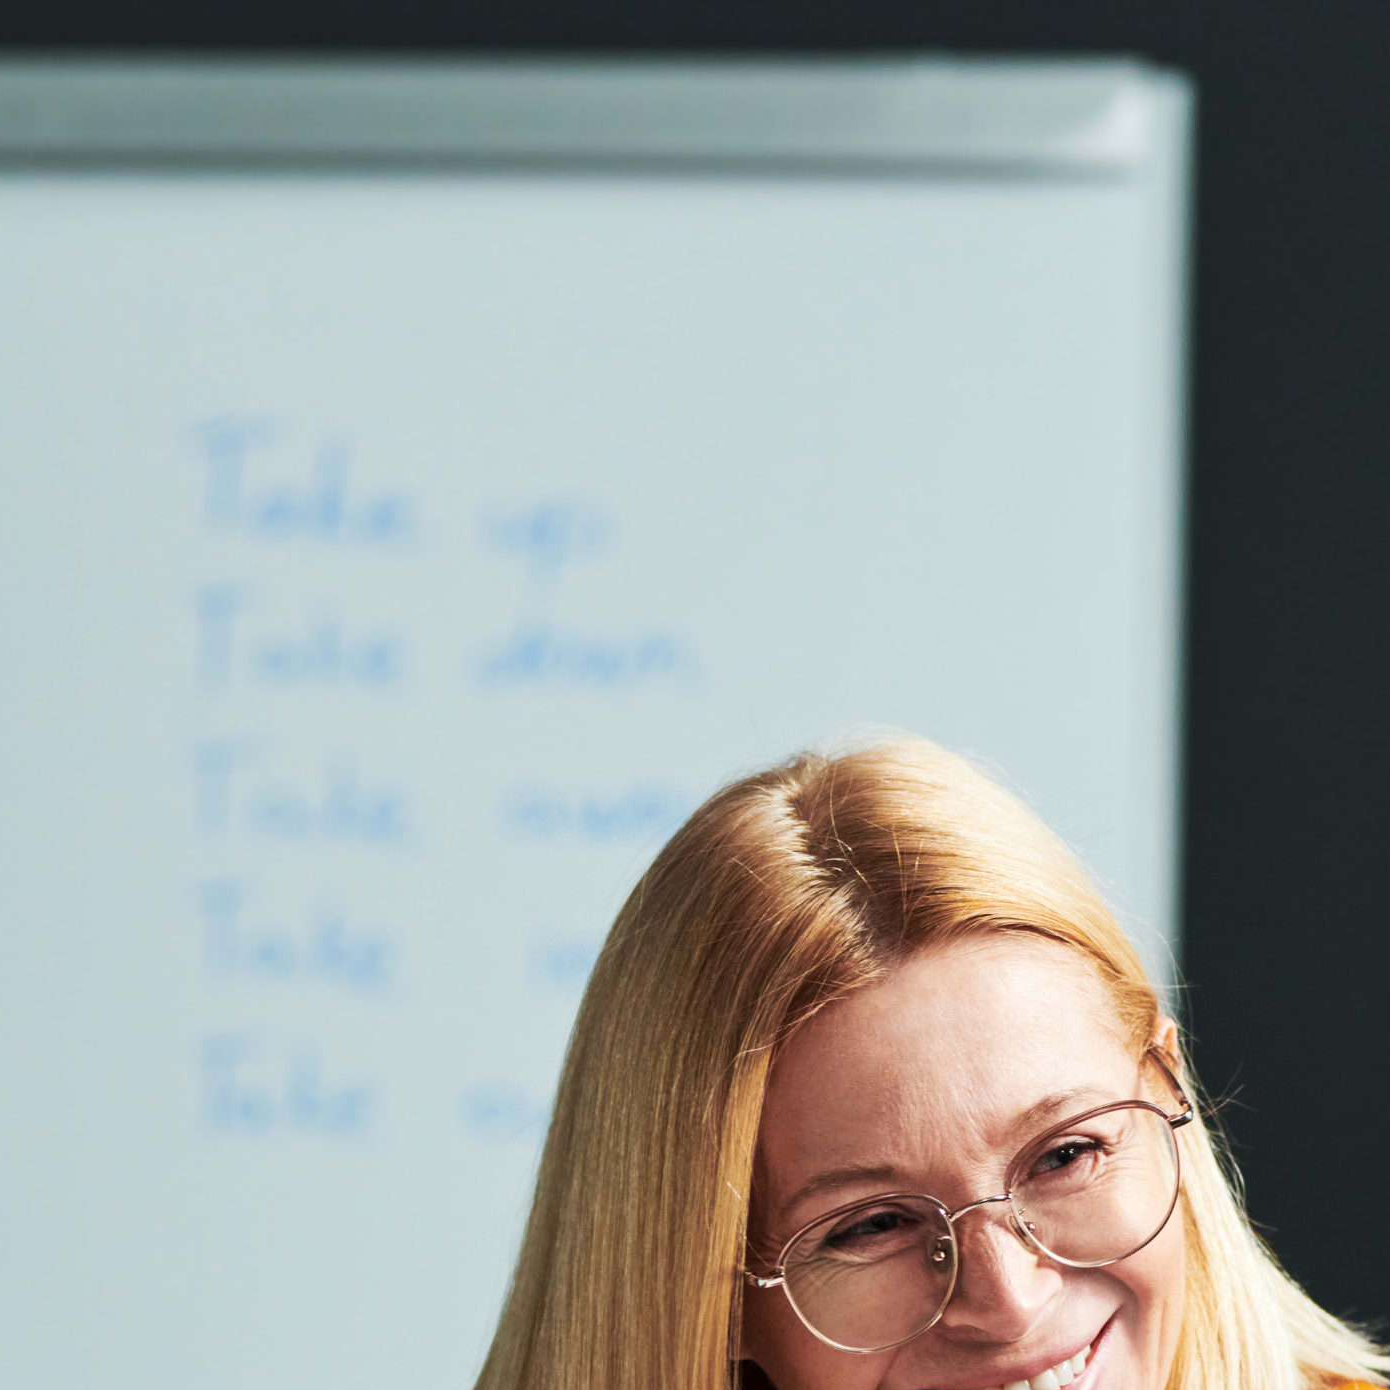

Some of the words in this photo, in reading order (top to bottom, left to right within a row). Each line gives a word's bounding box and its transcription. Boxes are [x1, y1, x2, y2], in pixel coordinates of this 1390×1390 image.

[187, 413, 416, 539] Take
[191, 580, 406, 692] Take
[191, 735, 416, 845] Take
[191, 875, 403, 991] Take
[191, 1031, 381, 1135] Take
